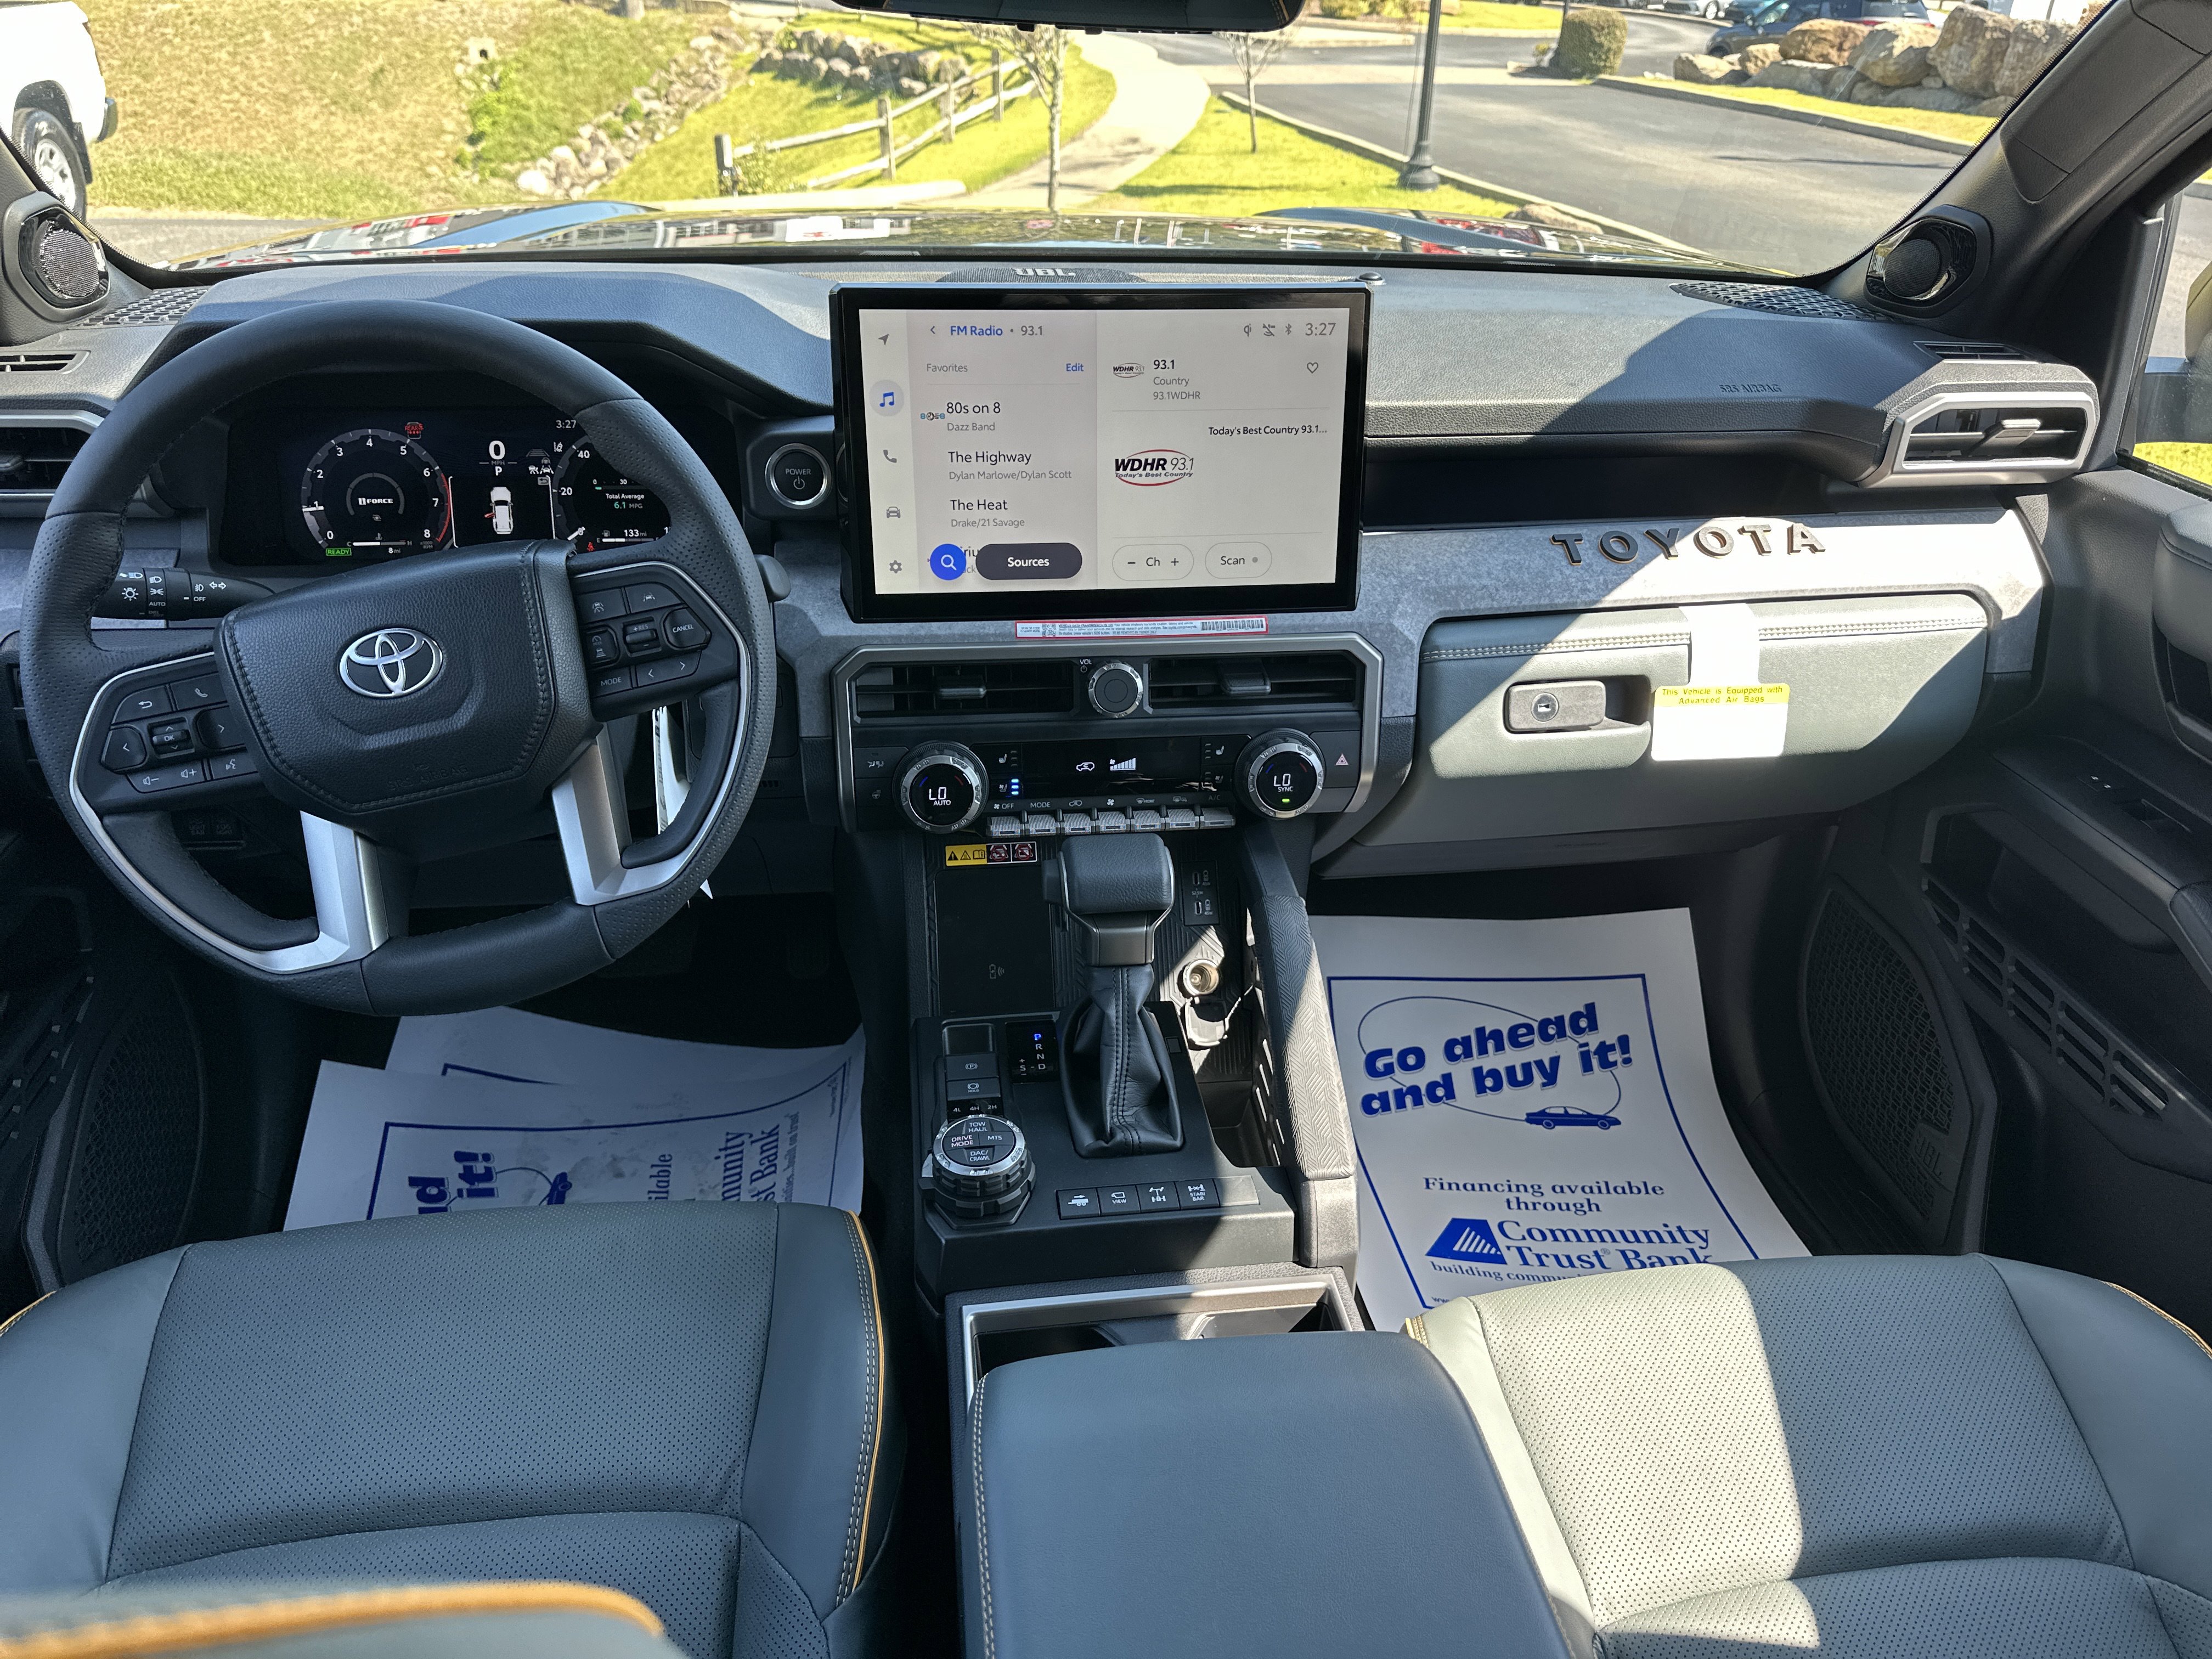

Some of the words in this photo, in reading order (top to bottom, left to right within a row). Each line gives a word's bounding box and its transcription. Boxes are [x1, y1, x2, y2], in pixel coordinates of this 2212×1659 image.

[950, 325, 967, 336] FM
[970, 325, 1003, 336] Radio
[1020, 326, 1043, 336] 93.1
[1305, 323, 1336, 336] 3:27
[927, 363, 968, 373] Favorites
[1066, 363, 1084, 372] Edit
[1153, 359, 1175, 370] 93.1
[1153, 376, 1189, 386] Country
[1153, 391, 1201, 400] 93.1WDHR
[946, 402, 969, 414] 80s
[973, 404, 989, 414] on
[994, 402, 1001, 414] 8
[556, 420, 576, 429] 3:27
[947, 422, 969, 431] Dazz
[972, 422, 995, 431] Band
[1209, 426, 1241, 435] Today's
[1243, 426, 1262, 435] Best
[1263, 425, 1300, 435] Country
[366, 438, 373, 447] 4
[336, 448, 343, 456] 3
[400, 446, 407, 455] 5
[489, 441, 505, 460] 0
[578, 450, 590, 459] 40
[948, 451, 972, 463] The
[975, 450, 1032, 465] Highway
[1114, 458, 1167, 472] WDHR
[1170, 457, 1194, 471] 93.1
[317, 470, 324, 478] 2
[423, 468, 430, 477] 6
[495, 466, 503, 476] P
[949, 471, 975, 481] Dylan
[978, 470, 1046, 481] Marlowe/Dylan
[1048, 470, 1071, 479] Scott
[561, 487, 572, 495] 20
[313, 501, 319, 509] 1
[432, 498, 439, 507] 7
[950, 499, 973, 510] The
[977, 499, 1008, 510] Heat
[951, 518, 990, 528] Drake/21
[992, 518, 1025, 528] Savage
[326, 531, 334, 540] 0
[424, 529, 431, 538] 8
[1549, 523, 1826, 566] TOYOTA
[1007, 557, 1049, 567] Sources
[1146, 556, 1160, 567] Ch
[1220, 555, 1245, 566] Scan
[672, 624, 694, 633] CANCEL
[600, 677, 622, 686] MODE
[1726, 687, 1763, 695] Equipped
[1363, 1046, 1426, 1080] Go
[1443, 1002, 1599, 1064] ahead
[1361, 1072, 1456, 1118] and
[1472, 1054, 1561, 1097] buy
[1577, 1034, 1633, 1076] it!
[749, 1124, 780, 1184] Bank
[714, 1131, 753, 1201] munity
[454, 1150, 499, 1200] it!
[647, 1153, 673, 1201] ilable
[1423, 1177, 1542, 1197] Financing
[1551, 1180, 1664, 1196] available
[1505, 1197, 1601, 1216] through
[1497, 1220, 1710, 1249] Community
[1617, 1247, 1713, 1269] Bank
[1430, 1261, 1503, 1281] building
